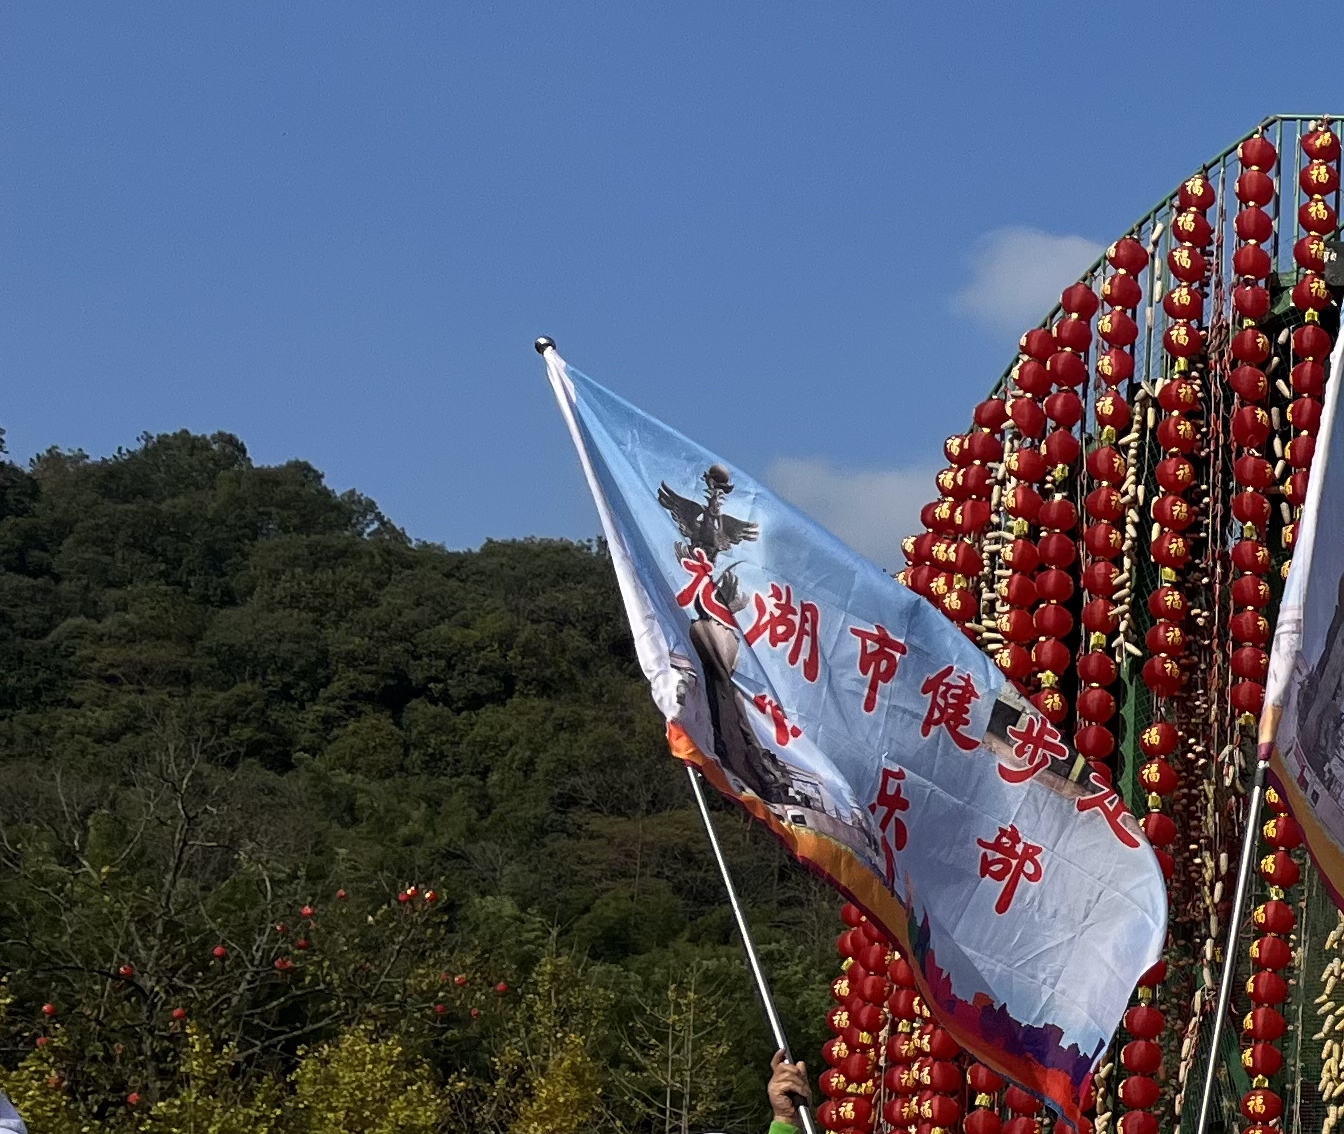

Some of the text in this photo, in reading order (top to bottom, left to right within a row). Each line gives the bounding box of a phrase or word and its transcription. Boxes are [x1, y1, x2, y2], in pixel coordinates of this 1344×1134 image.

[1314, 132, 1331, 148] 福
[1310, 162, 1329, 183] 福
[1186, 175, 1203, 196] 福
[1308, 199, 1327, 220] 福
[1177, 210, 1197, 231] 福
[1174, 249, 1191, 268] 福
[1308, 240, 1325, 259] 福
[1171, 282, 1190, 305] 福
[1310, 278, 1327, 299] 福
[1099, 315, 1115, 333] 福
[1171, 324, 1188, 345] 福
[1097, 396, 1114, 415] 福
[947, 439, 961, 456] 福
[934, 497, 954, 520] 福
[1168, 538, 1185, 557] 福
[1164, 591, 1182, 609] 福
[1166, 628, 1181, 644] 福
[1044, 694, 1062, 712] 福
[1142, 727, 1160, 746] 福
[1142, 764, 1160, 783] 福
[834, 976, 849, 996] 福
[832, 1011, 849, 1028] 福
[832, 1039, 849, 1058] 福
[839, 1100, 855, 1119] 福
[1247, 1092, 1265, 1113] 福
